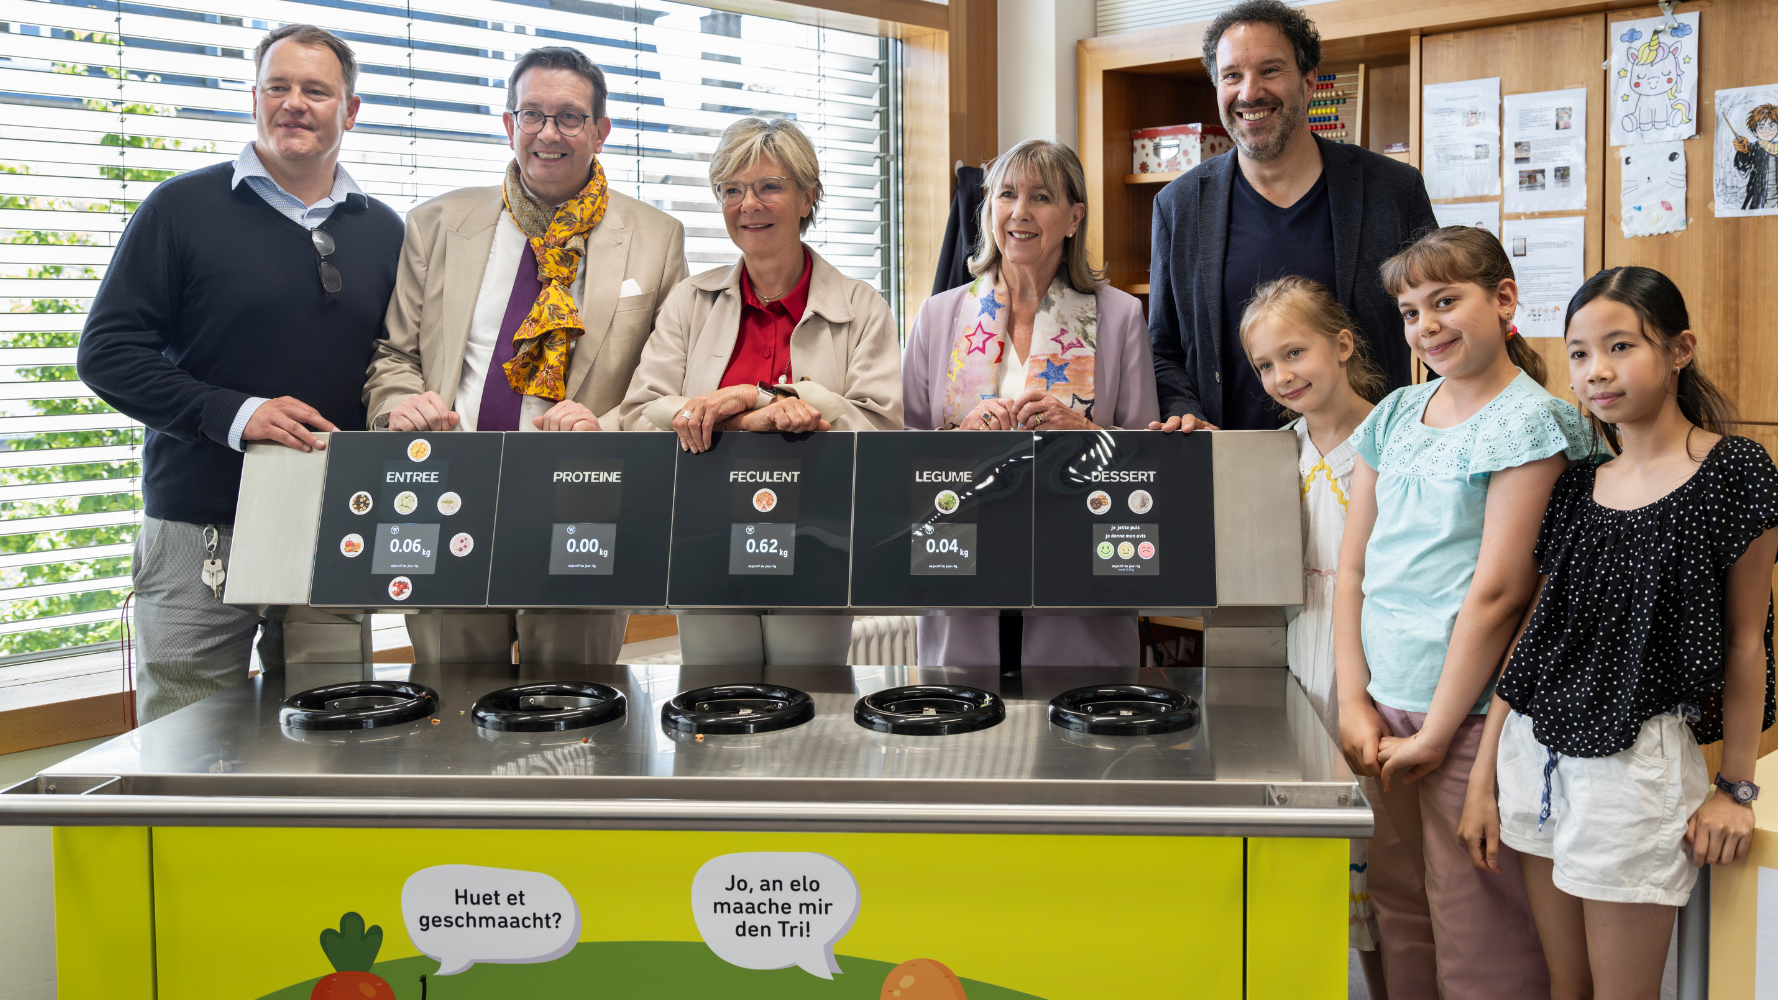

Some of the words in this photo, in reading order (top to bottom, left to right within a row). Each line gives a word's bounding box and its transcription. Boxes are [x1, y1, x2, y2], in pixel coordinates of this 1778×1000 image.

[386, 472, 439, 483] ENTREE
[553, 472, 621, 482] PROTEINE
[730, 471, 800, 482] FECULENT
[916, 471, 972, 482] LEGUME
[1091, 471, 1156, 482] DESSERT
[390, 538, 421, 553] 0.06
[421, 548, 431, 558] kg
[566, 538, 599, 553] 0.00
[599, 548, 608, 558] kg
[746, 538, 778, 553] 0.62
[779, 548, 788, 558] kg
[926, 538, 959, 553] 0.04
[959, 548, 969, 558] kg
[725, 875, 753, 893] Jo,
[760, 879, 782, 891] an
[790, 875, 819, 892] elo
[455, 889, 500, 905] Huet
[507, 891, 525, 905] et
[714, 898, 791, 914] maache
[799, 898, 833, 914] mir
[419, 912, 561, 931] geschmaacht?
[736, 921, 771, 937] den
[778, 921, 810, 937] Tri!
